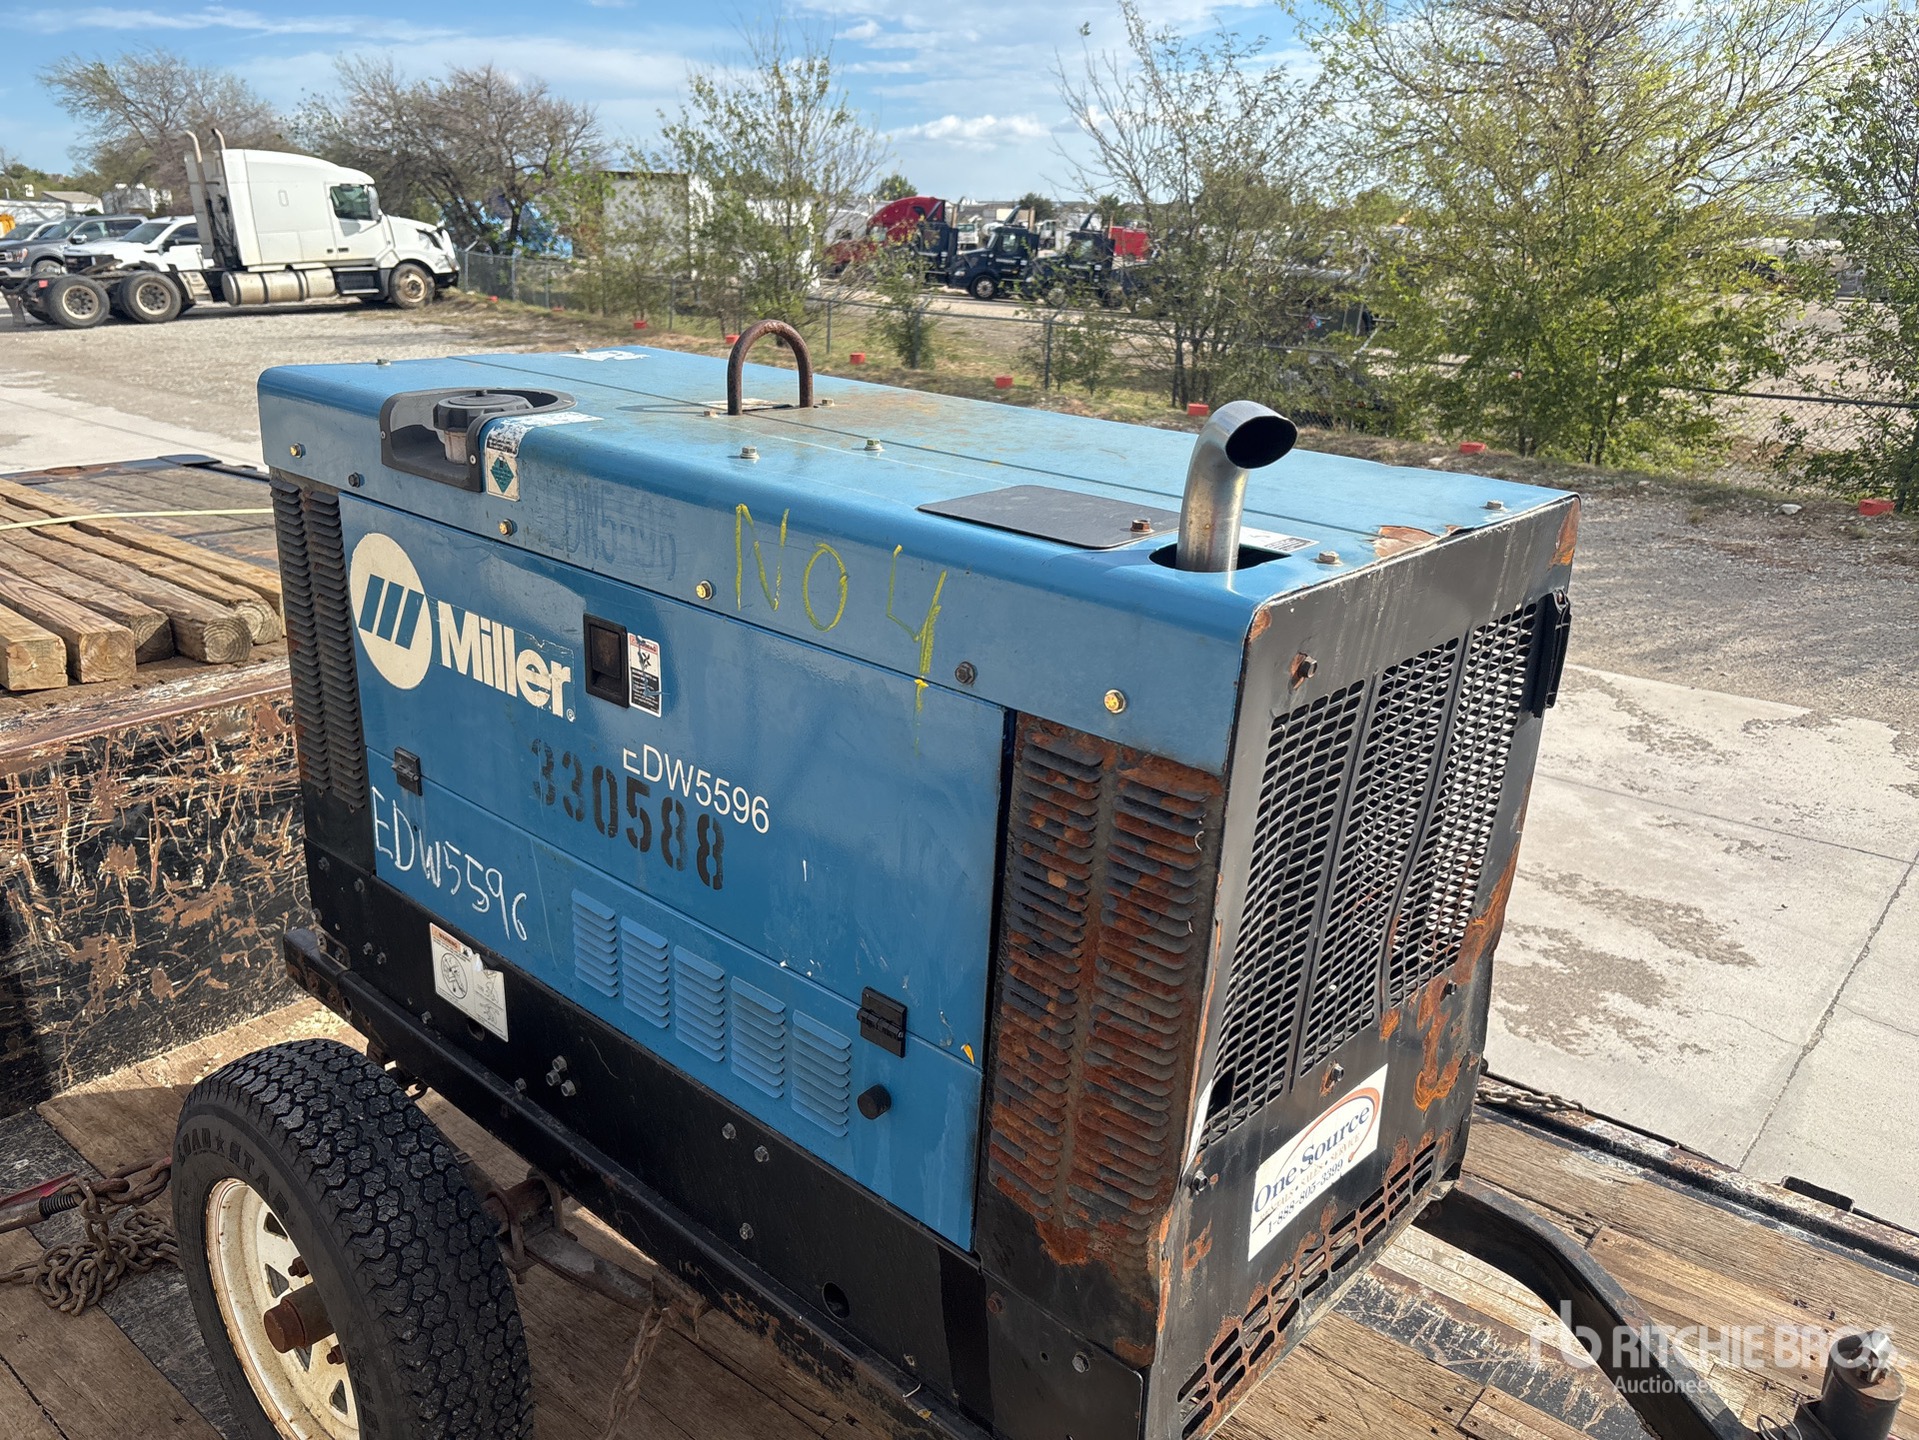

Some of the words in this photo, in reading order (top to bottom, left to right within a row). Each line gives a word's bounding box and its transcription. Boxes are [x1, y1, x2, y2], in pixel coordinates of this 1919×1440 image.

[437, 600, 572, 718] Miller
[531, 738, 725, 891] 330588
[622, 743, 770, 834] EDW5596
[371, 785, 528, 942] EDW5596
[1254, 1167, 1297, 1213] One
[1300, 1106, 1370, 1174] Source
